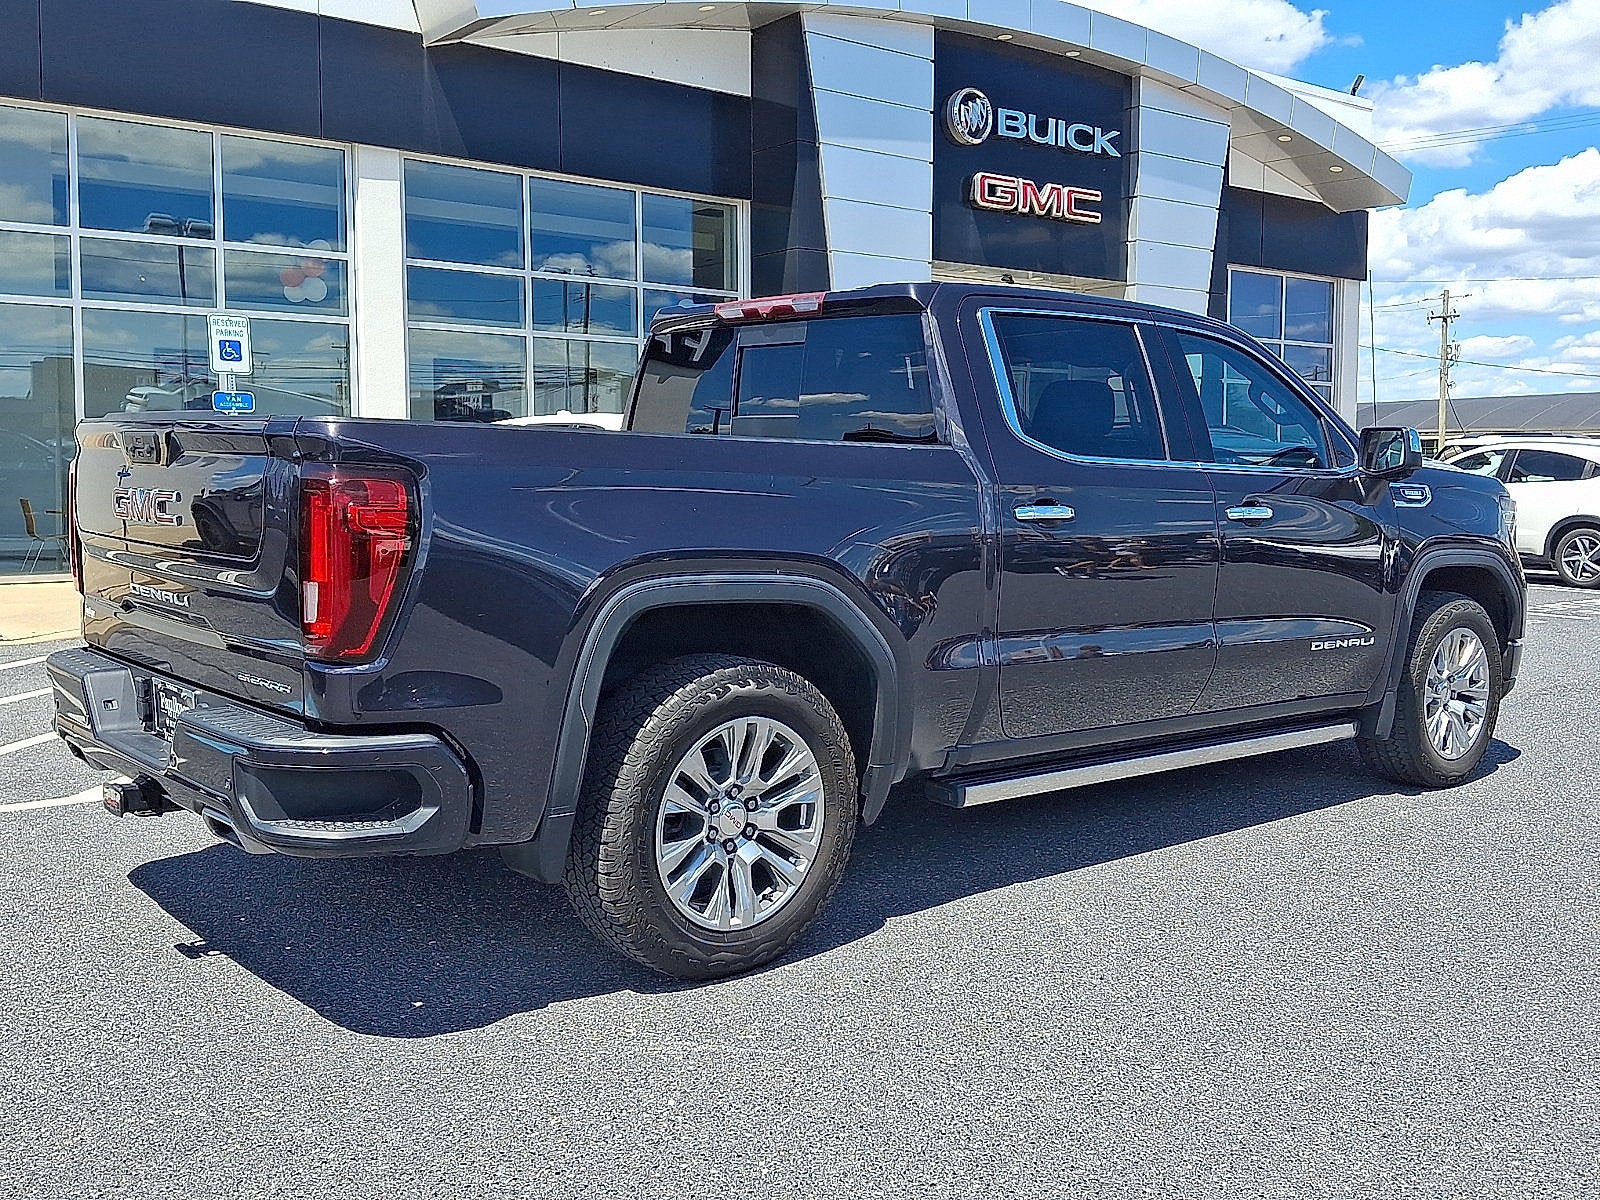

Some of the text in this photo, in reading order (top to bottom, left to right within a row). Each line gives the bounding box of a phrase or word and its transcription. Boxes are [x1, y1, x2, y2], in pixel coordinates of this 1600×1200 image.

[997, 107, 1122, 157] BUICK
[971, 171, 1103, 224] GMC
[212, 318, 247, 328] RESERVED
[215, 329, 244, 338] PARKING
[111, 487, 183, 527] GMC
[129, 582, 191, 607] DENALI
[1310, 636, 1375, 651] DENALI
[237, 671, 292, 694] SIERRA
[724, 810, 742, 829] GMC
